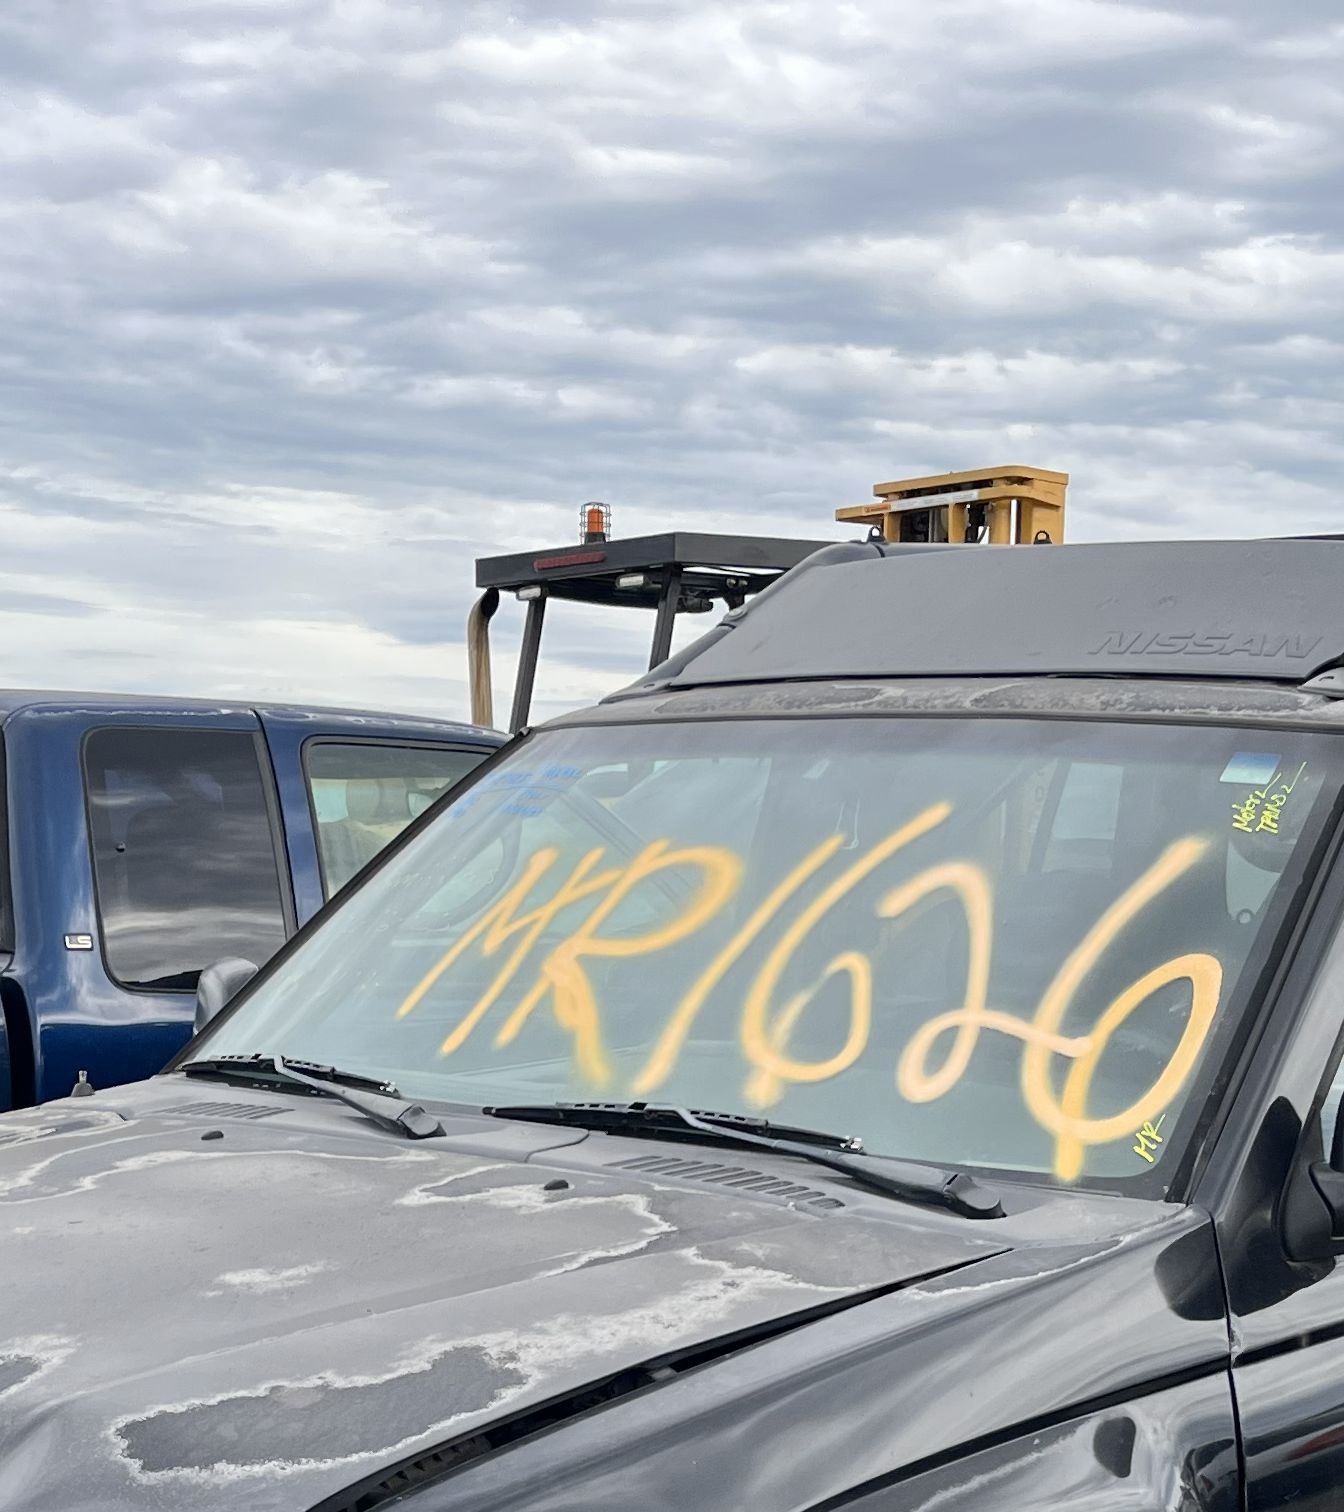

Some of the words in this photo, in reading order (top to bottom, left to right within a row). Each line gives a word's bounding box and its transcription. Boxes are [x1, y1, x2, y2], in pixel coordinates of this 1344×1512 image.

[1088, 632, 1324, 658] NISSAN
[65, 935, 92, 949] LS
[394, 801, 1224, 1181] MR1626
